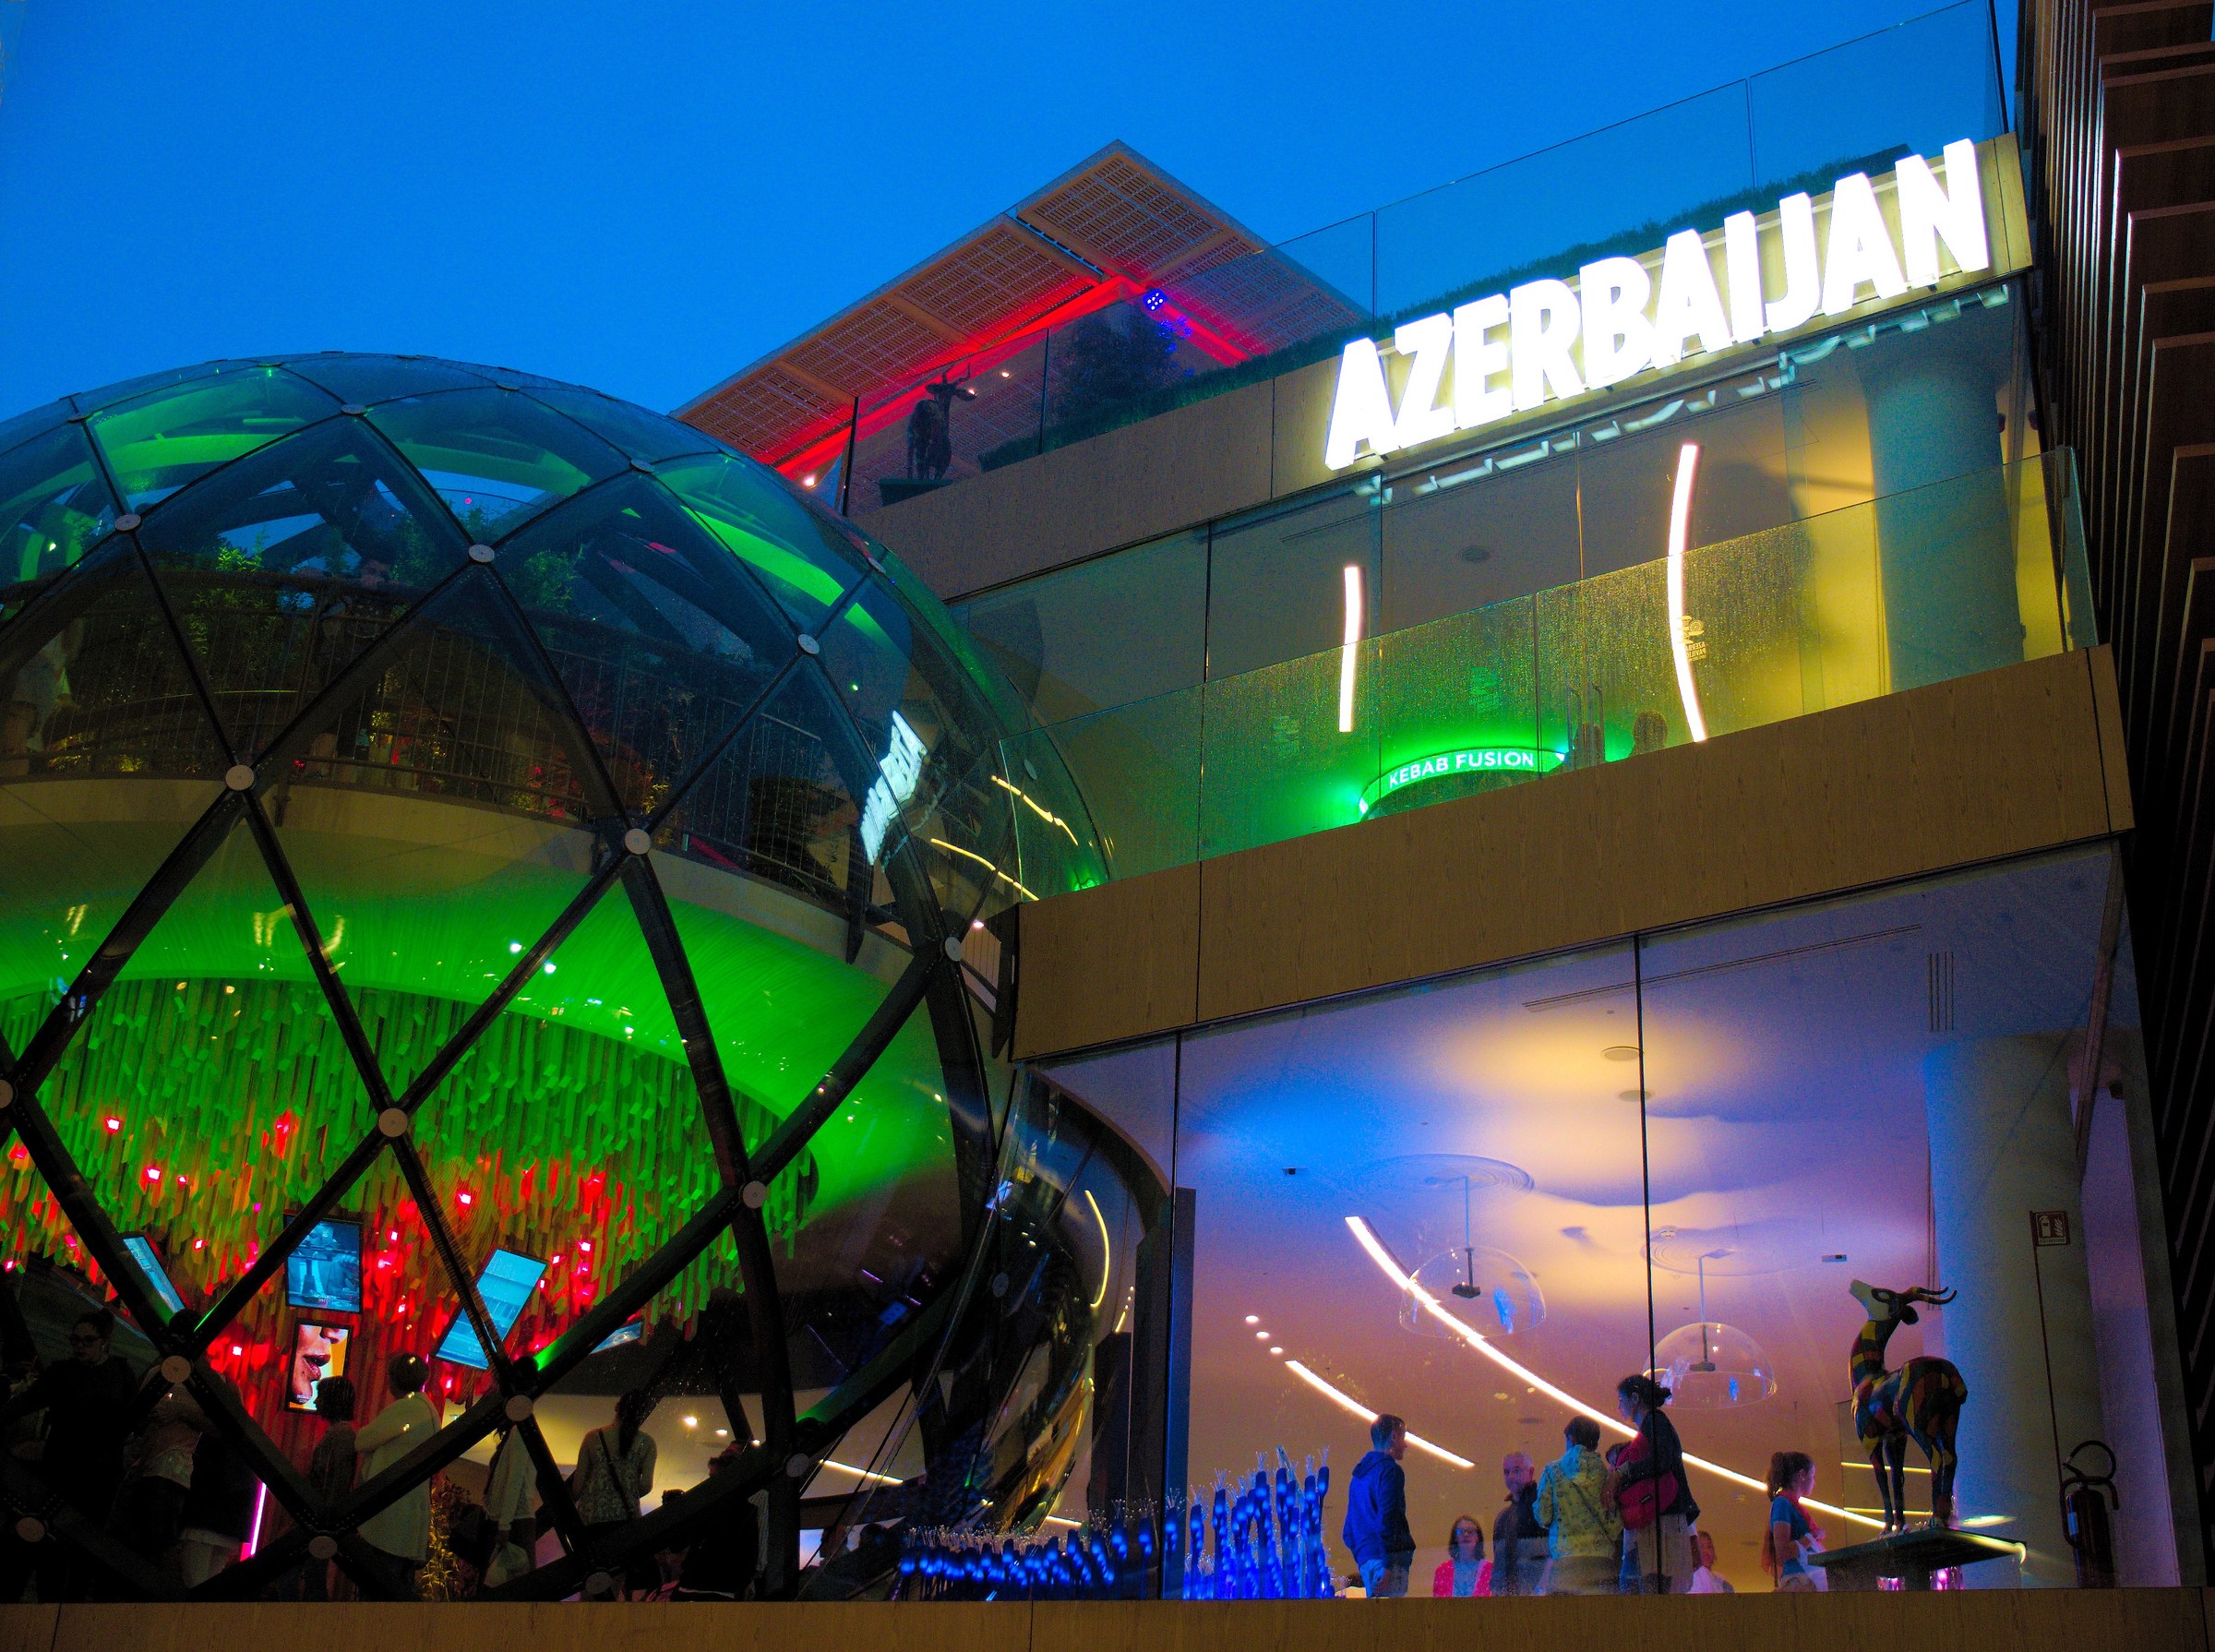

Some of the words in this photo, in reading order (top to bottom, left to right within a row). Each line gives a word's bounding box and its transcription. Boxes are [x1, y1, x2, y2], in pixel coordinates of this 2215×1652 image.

[1325, 138, 1990, 471] AZERBAIJAN
[1389, 757, 1449, 788] KEBAB
[1455, 751, 1534, 769] FUSION
